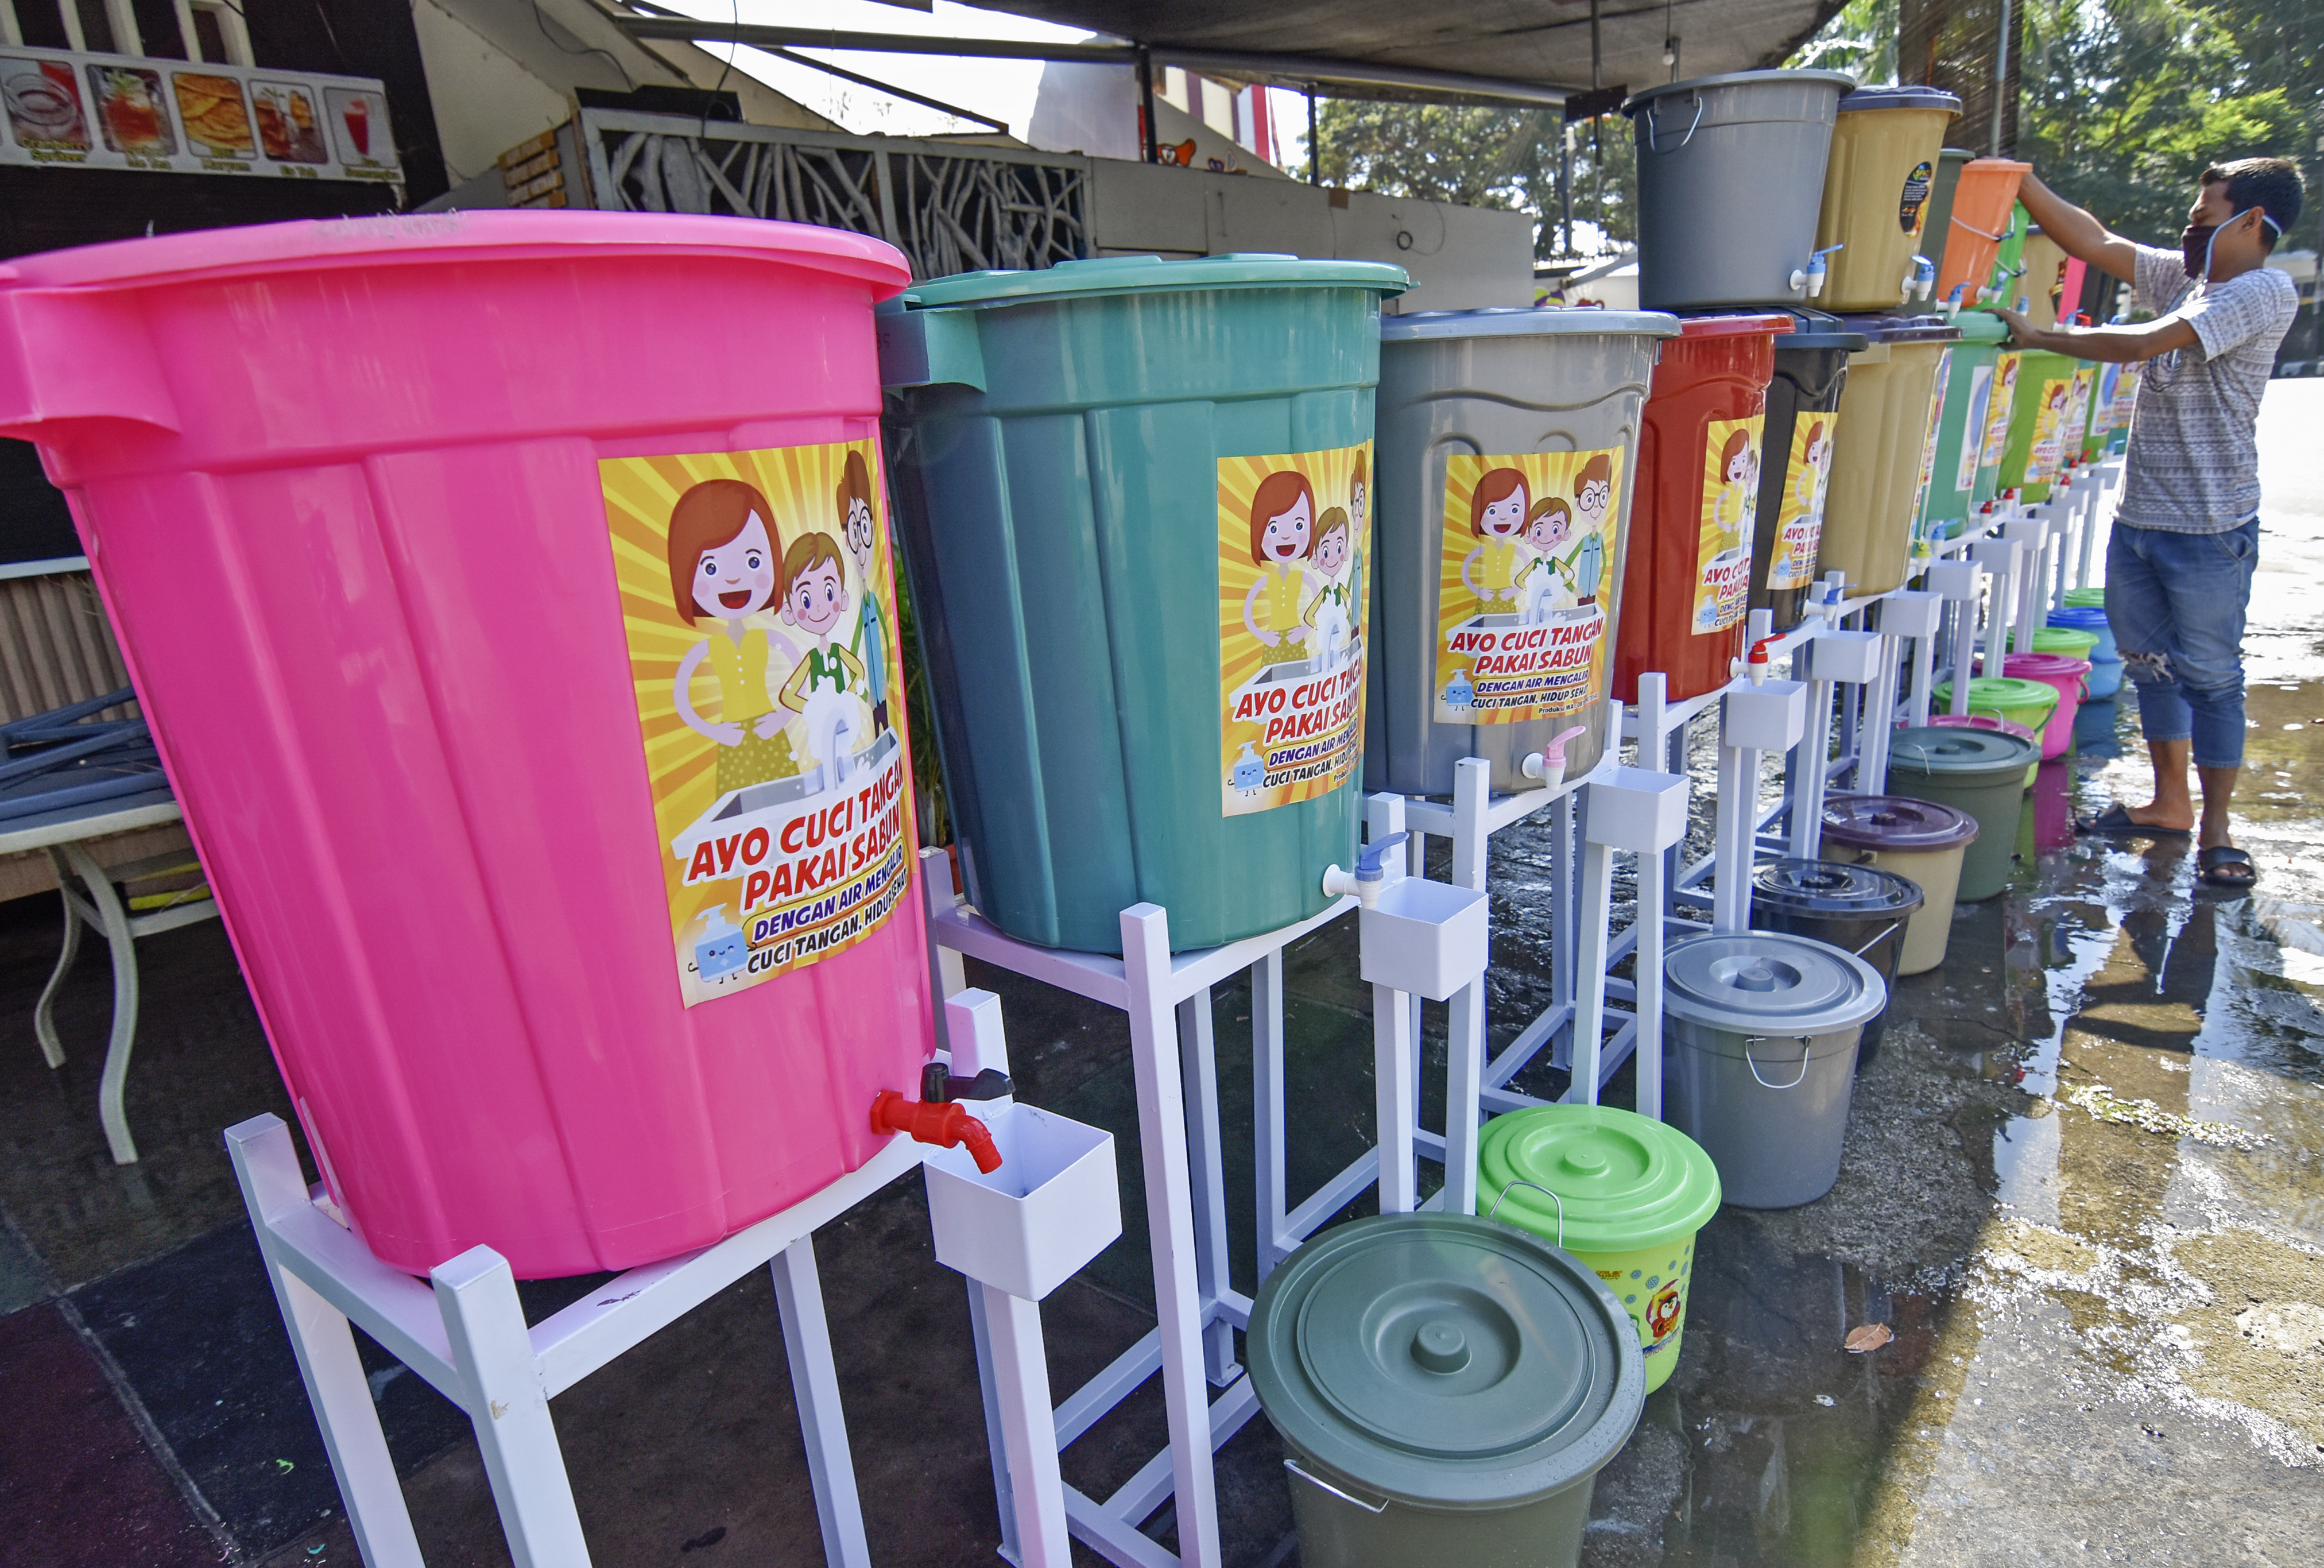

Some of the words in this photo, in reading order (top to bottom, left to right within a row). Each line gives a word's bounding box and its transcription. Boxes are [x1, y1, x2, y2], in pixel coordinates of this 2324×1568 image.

[1784, 528, 1804, 540] AYO
[1703, 567, 1730, 584] AYO
[1450, 632, 1497, 652] AYO
[1501, 629, 1548, 650] CUCI
[1551, 617, 1603, 646] TANGAN
[1475, 652, 1537, 674] PAKAI
[1537, 644, 1593, 669] SABUN
[1477, 679, 1525, 692] DENGAN
[1525, 677, 1543, 688] AIR
[1544, 669, 1589, 687] MENGALIR
[1235, 688, 1286, 719] AYO
[1292, 676, 1337, 709] CUCI
[1470, 697, 1497, 708] CUCI
[1497, 694, 1538, 708] TANGAN,
[1540, 691, 1569, 703] HIDUP
[1570, 684, 1589, 699] SEHAT
[1539, 706, 1565, 714] Produksi
[1265, 706, 1330, 743] PAKAI
[1269, 744, 1321, 766] DENGAN
[1321, 737, 1335, 753] AIR
[1263, 771, 1289, 788] CUCI
[1292, 759, 1333, 781] TANGAN,
[687, 827, 770, 881] AYO
[780, 797, 854, 854] CUCI
[859, 756, 903, 822] TANGAN
[745, 848, 846, 911] PAKAI
[851, 800, 900, 872] SABUN
[755, 899, 836, 941] DENGAN
[839, 882, 862, 911] AIR
[865, 844, 903, 896] MENGALIR
[747, 940, 791, 974] CUCI
[796, 913, 862, 956] TANGAN,
[865, 889, 892, 926] HIDUP
